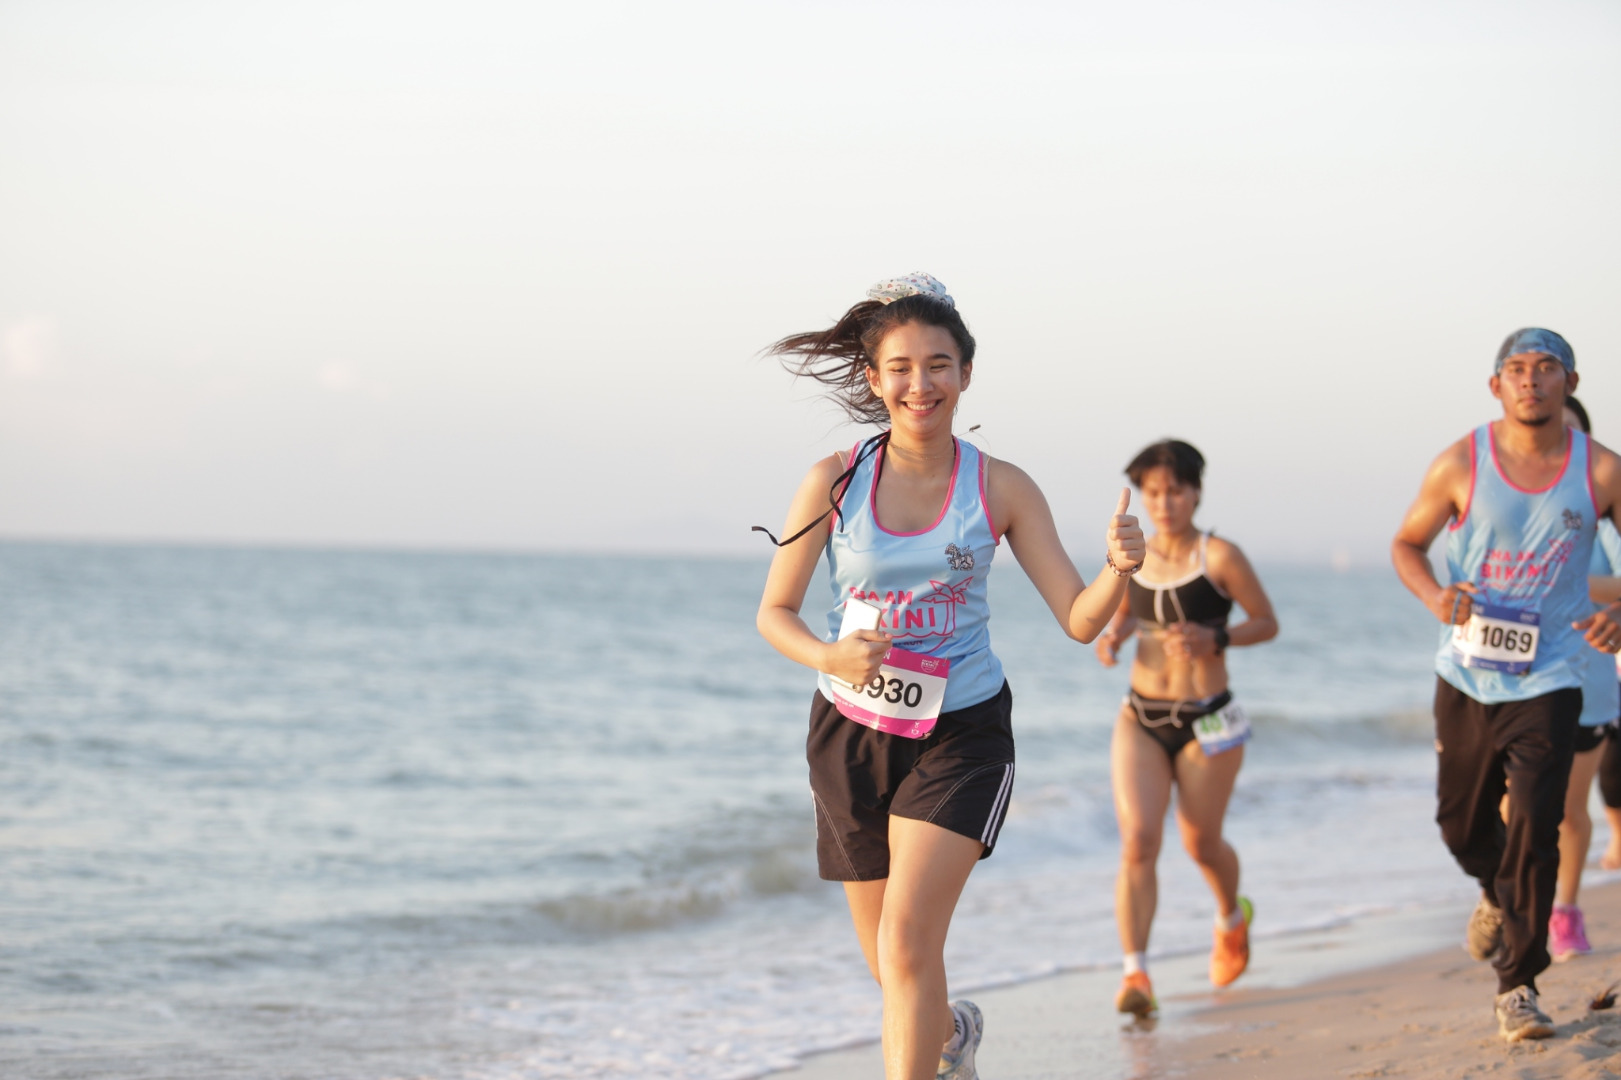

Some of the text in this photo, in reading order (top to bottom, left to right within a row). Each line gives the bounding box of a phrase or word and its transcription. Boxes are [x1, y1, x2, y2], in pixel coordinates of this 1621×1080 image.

[1481, 563, 1549, 580] BIKINI
[885, 590, 913, 605] AM
[879, 606, 936, 629] KINI
[1481, 624, 1533, 653] 1069
